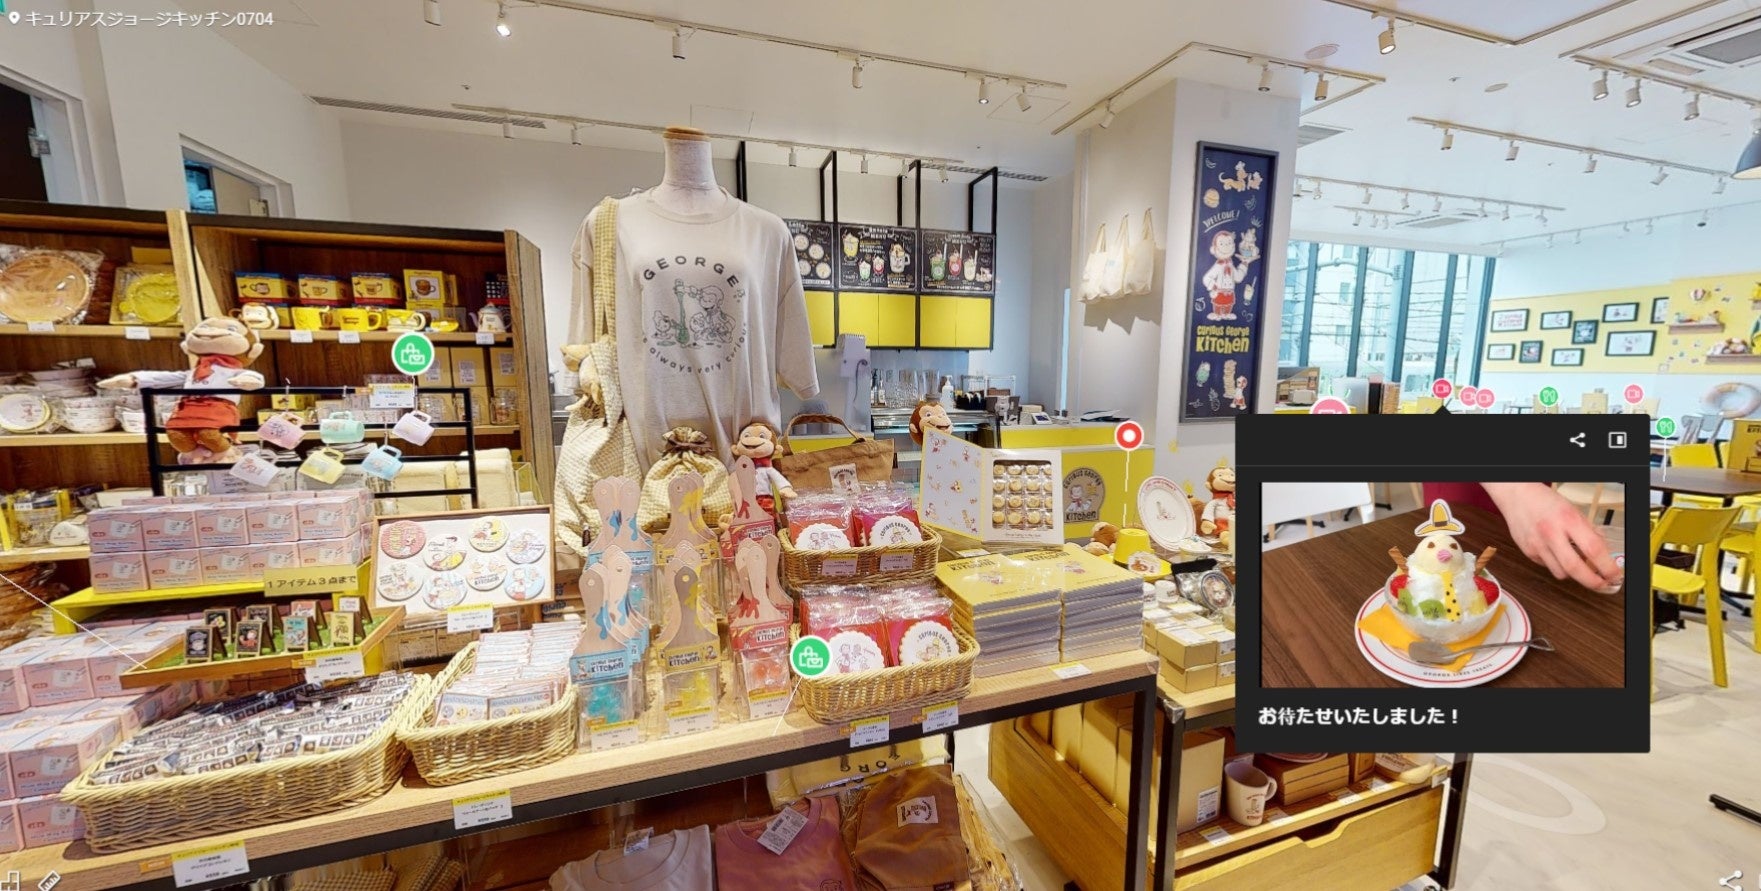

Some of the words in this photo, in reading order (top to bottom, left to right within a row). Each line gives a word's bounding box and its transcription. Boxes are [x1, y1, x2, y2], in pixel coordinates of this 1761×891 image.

[643, 255, 739, 288] GEORGE
[649, 347, 692, 373] always
[697, 362, 721, 374] very
